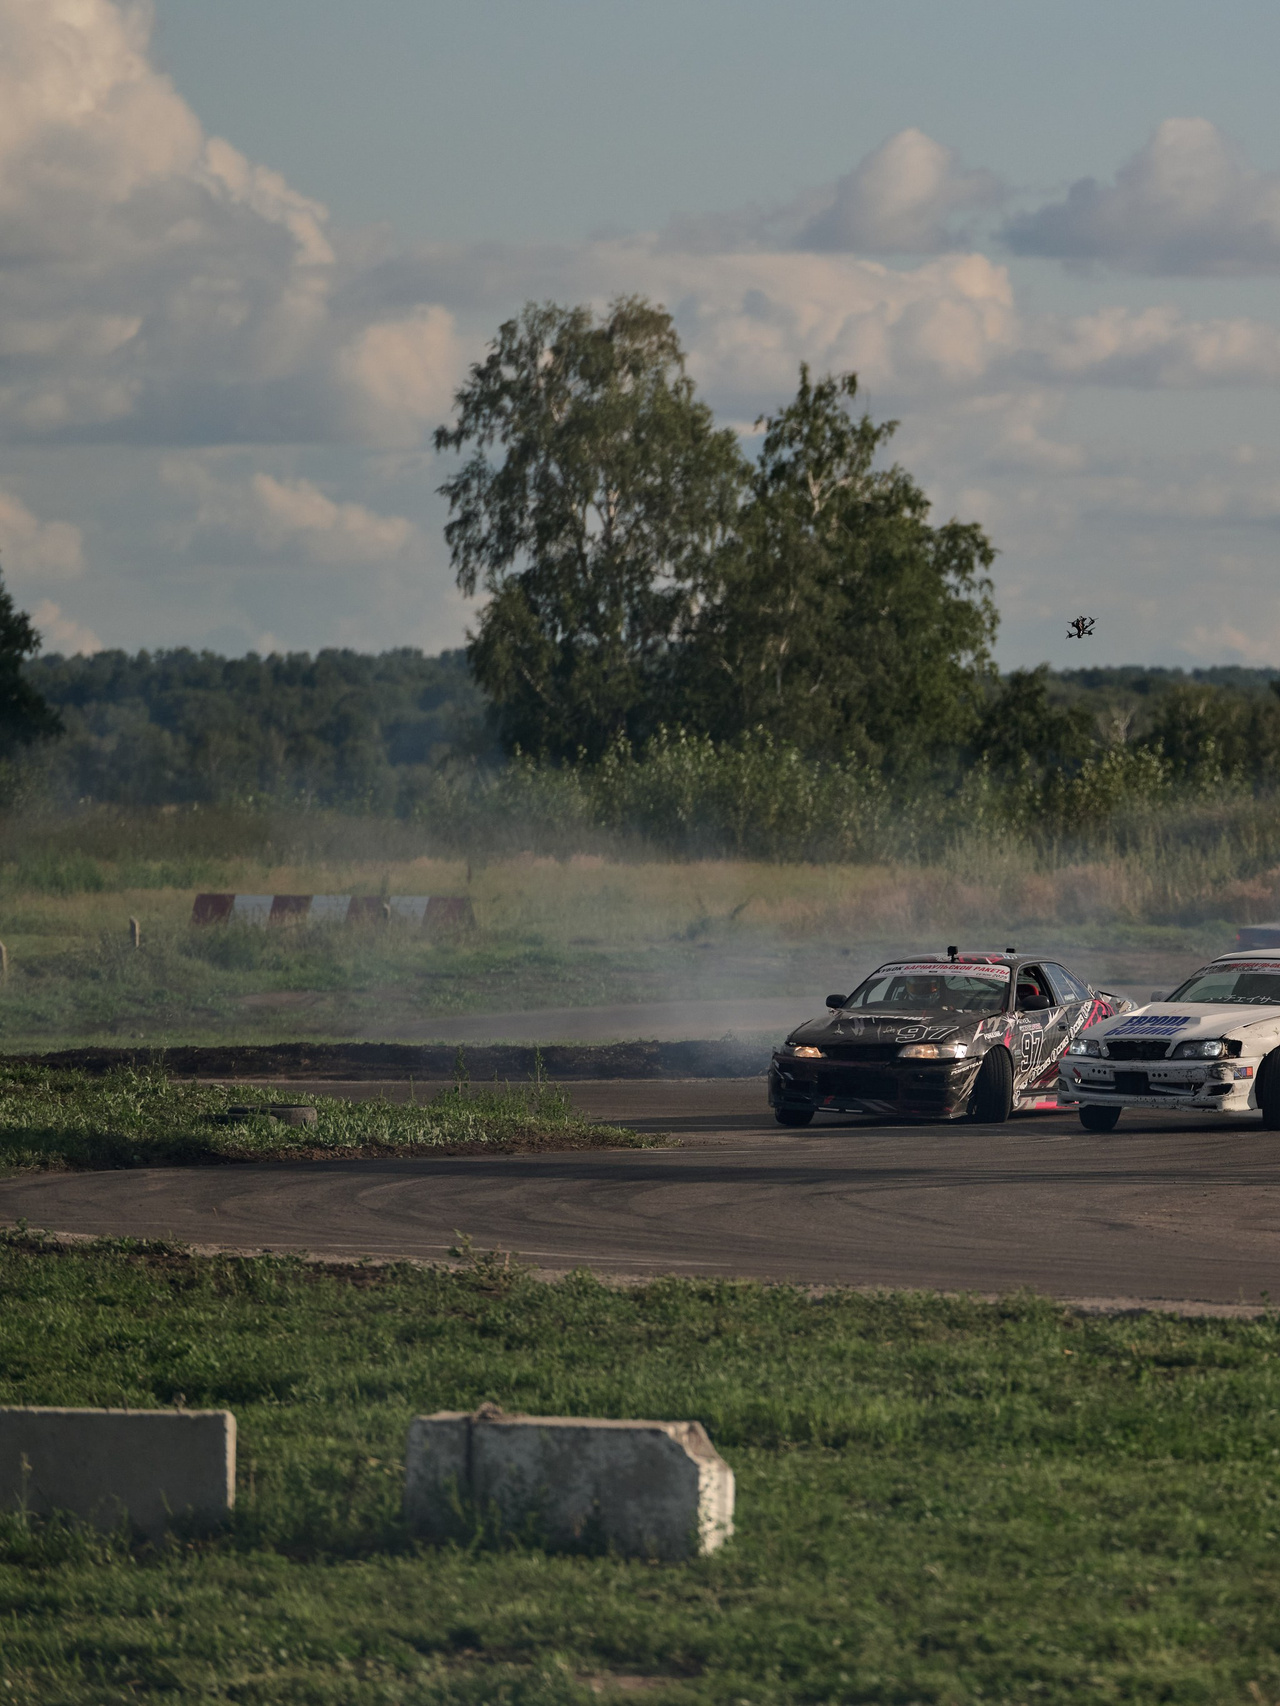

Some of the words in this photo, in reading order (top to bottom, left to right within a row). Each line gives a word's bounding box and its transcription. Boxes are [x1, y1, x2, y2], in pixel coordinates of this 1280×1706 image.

[973, 966, 1010, 976] РАКЕТЫ
[1119, 1015, 1192, 1027] ЕВРОПА
[895, 1024, 960, 1043] 97
[1020, 1029, 1044, 1073] 97
